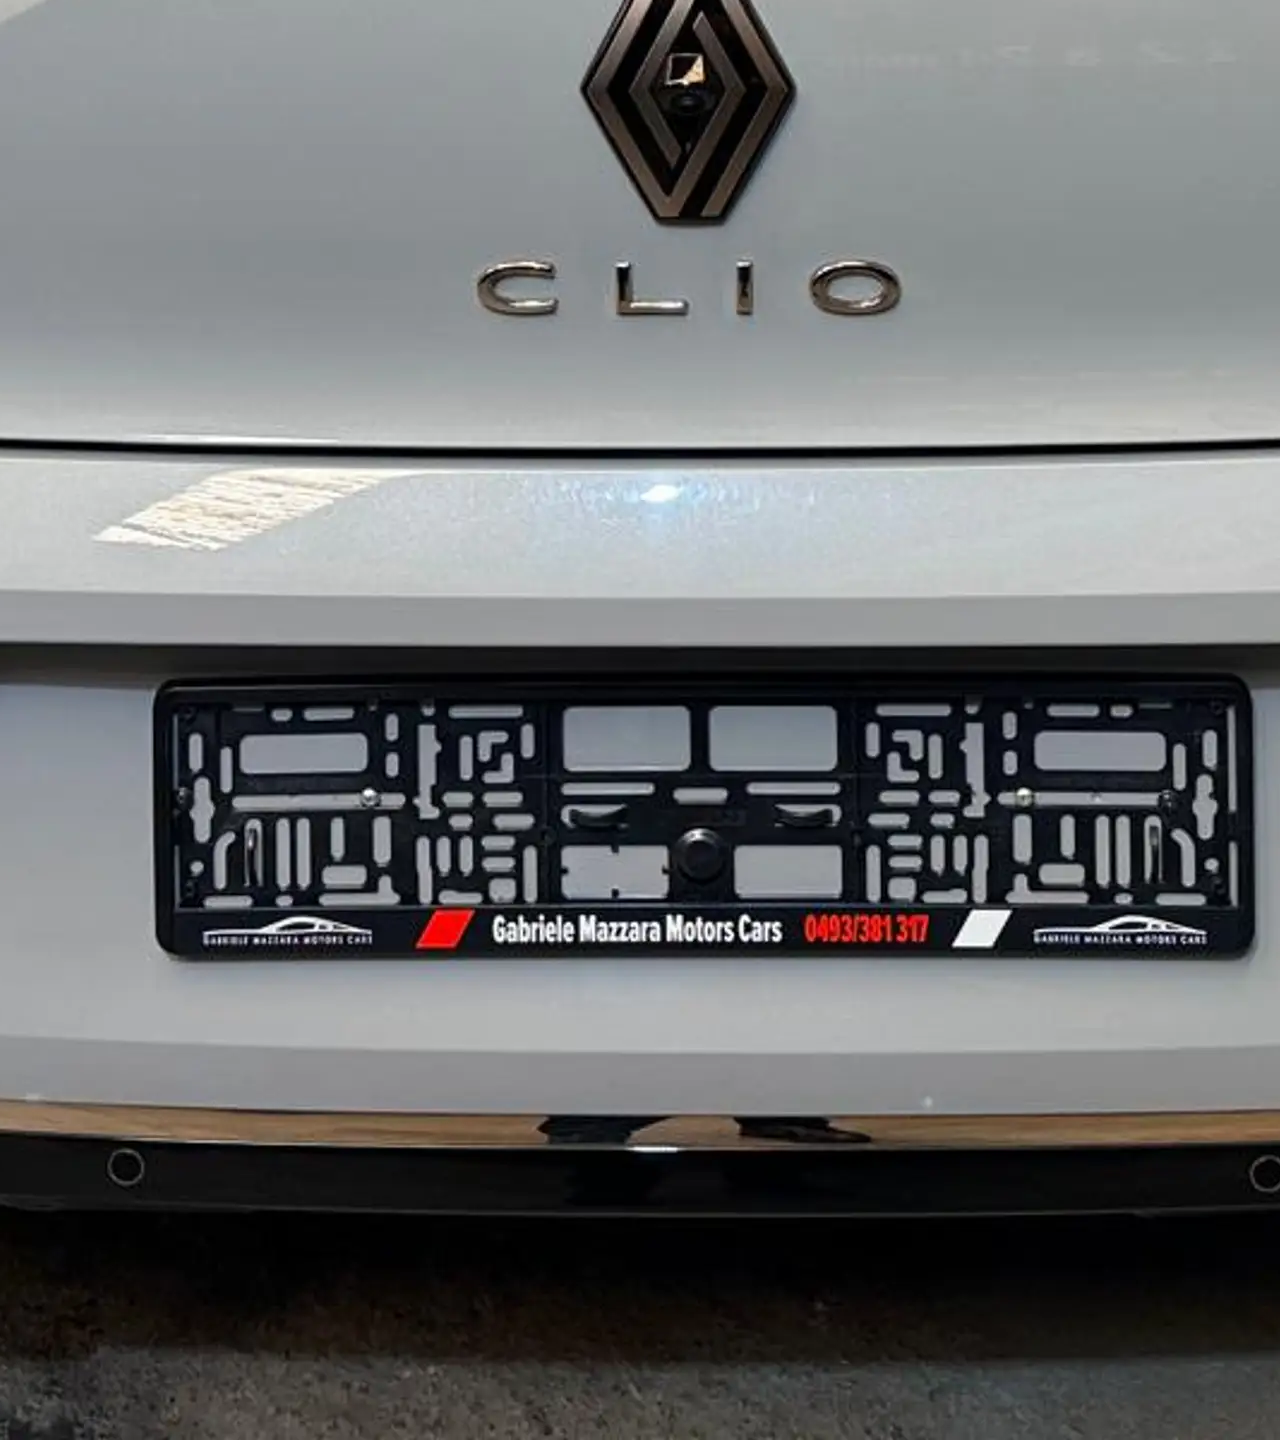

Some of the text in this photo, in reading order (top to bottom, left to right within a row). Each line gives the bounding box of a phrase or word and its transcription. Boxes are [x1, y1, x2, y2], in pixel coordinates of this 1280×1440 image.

[477, 260, 902, 316] CLIO
[492, 914, 575, 943] Gabriele
[578, 914, 661, 943] Mazzara
[666, 914, 735, 943] Motors
[738, 914, 784, 943] Cars
[895, 913, 930, 943] 317
